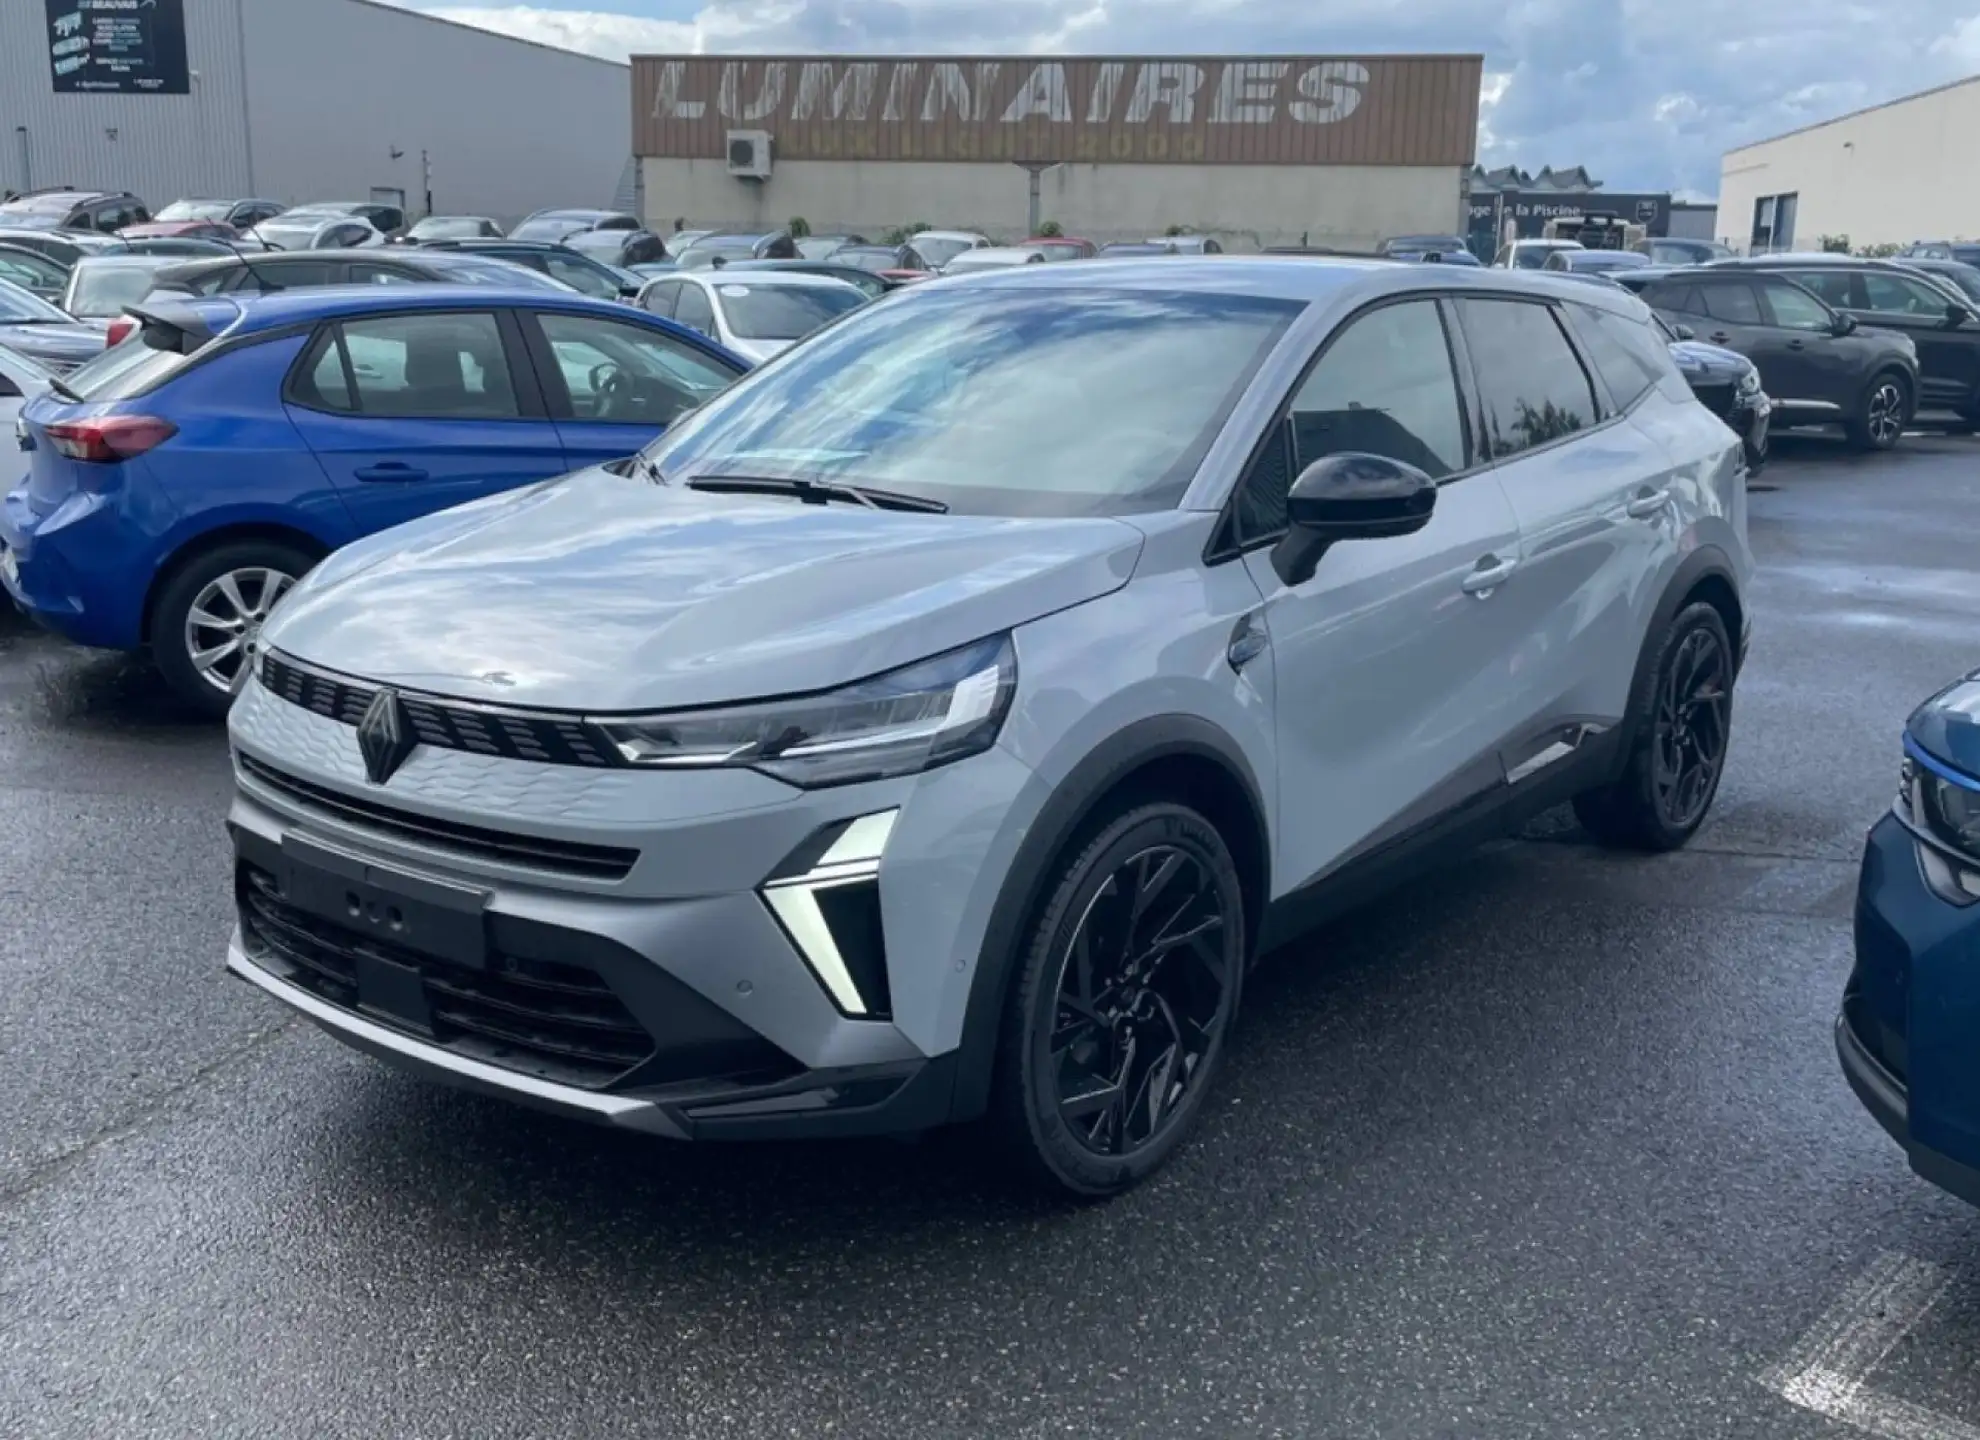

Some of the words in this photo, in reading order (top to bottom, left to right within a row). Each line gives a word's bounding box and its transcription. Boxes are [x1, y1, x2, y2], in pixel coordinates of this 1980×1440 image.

[652, 60, 1371, 124] LUMINAIRES
[1077, 131, 1206, 156] 2000
[1516, 204, 1529, 216] la
[1533, 203, 1581, 217] Piscine
